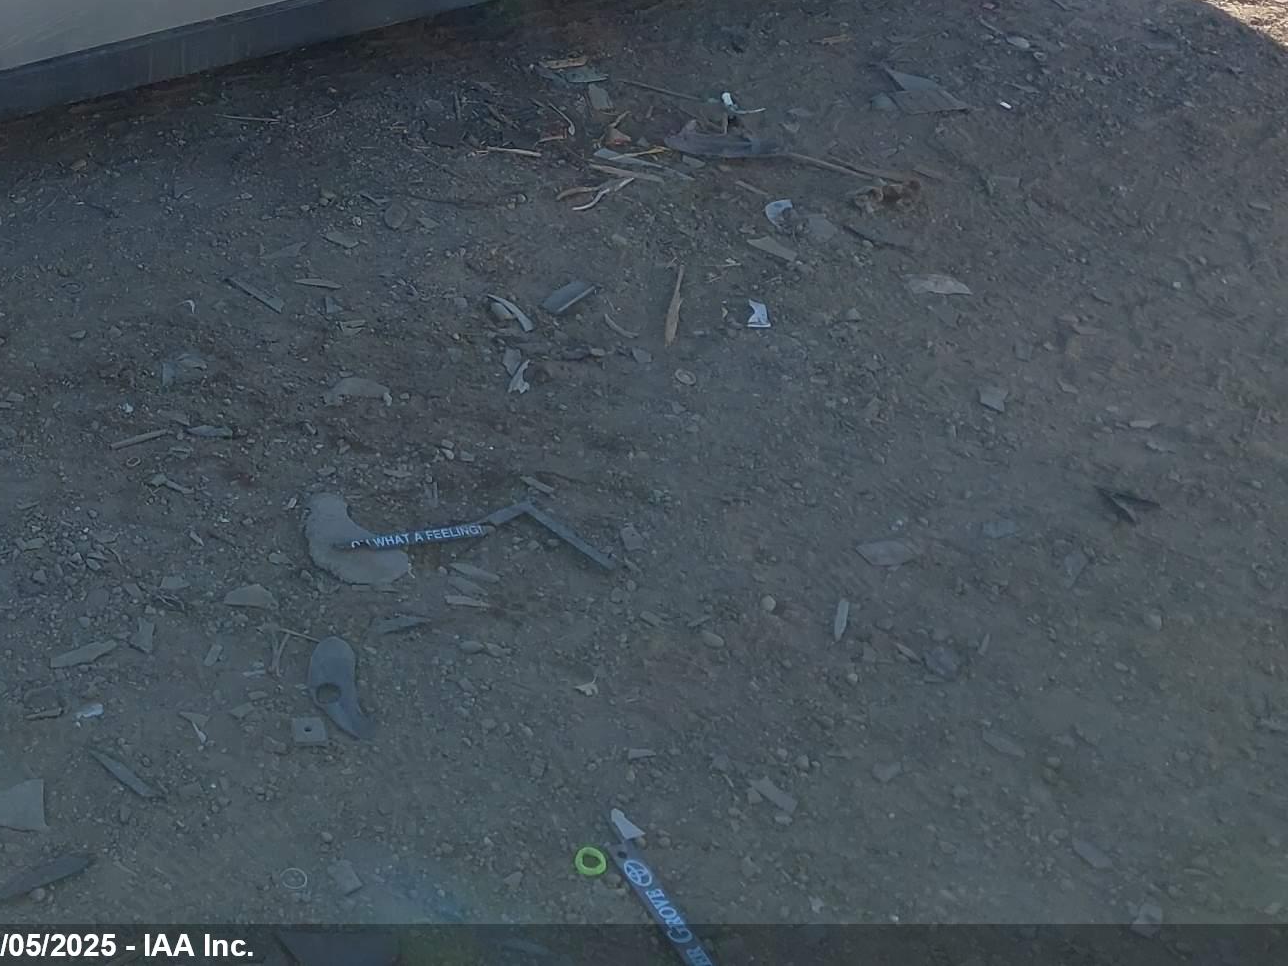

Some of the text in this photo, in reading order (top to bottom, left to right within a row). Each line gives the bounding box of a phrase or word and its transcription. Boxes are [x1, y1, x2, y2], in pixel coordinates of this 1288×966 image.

[374, 534, 409, 547] WHAT
[414, 532, 424, 542] A
[426, 524, 483, 540] FEELING!
